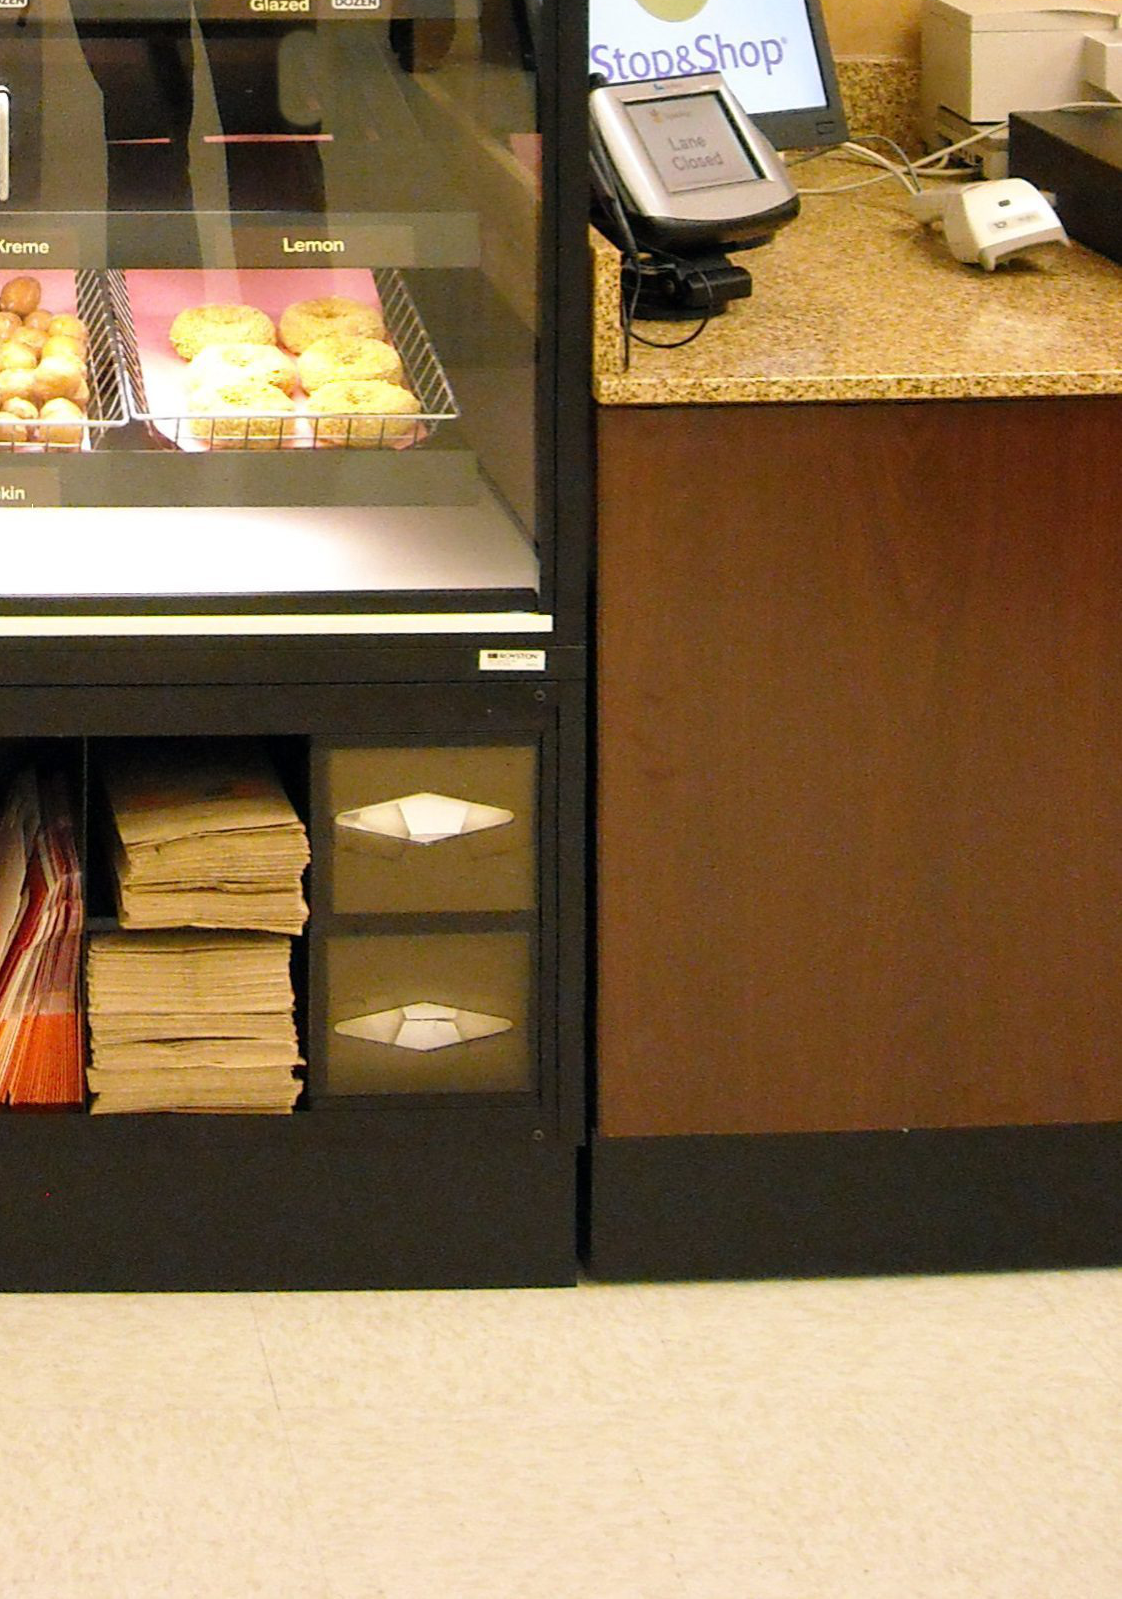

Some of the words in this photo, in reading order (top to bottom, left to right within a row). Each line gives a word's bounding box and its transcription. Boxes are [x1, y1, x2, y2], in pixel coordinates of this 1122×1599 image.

[669, 134, 707, 152] Lane
[672, 152, 725, 172] Closed
[283, 237, 346, 253] Lemon
